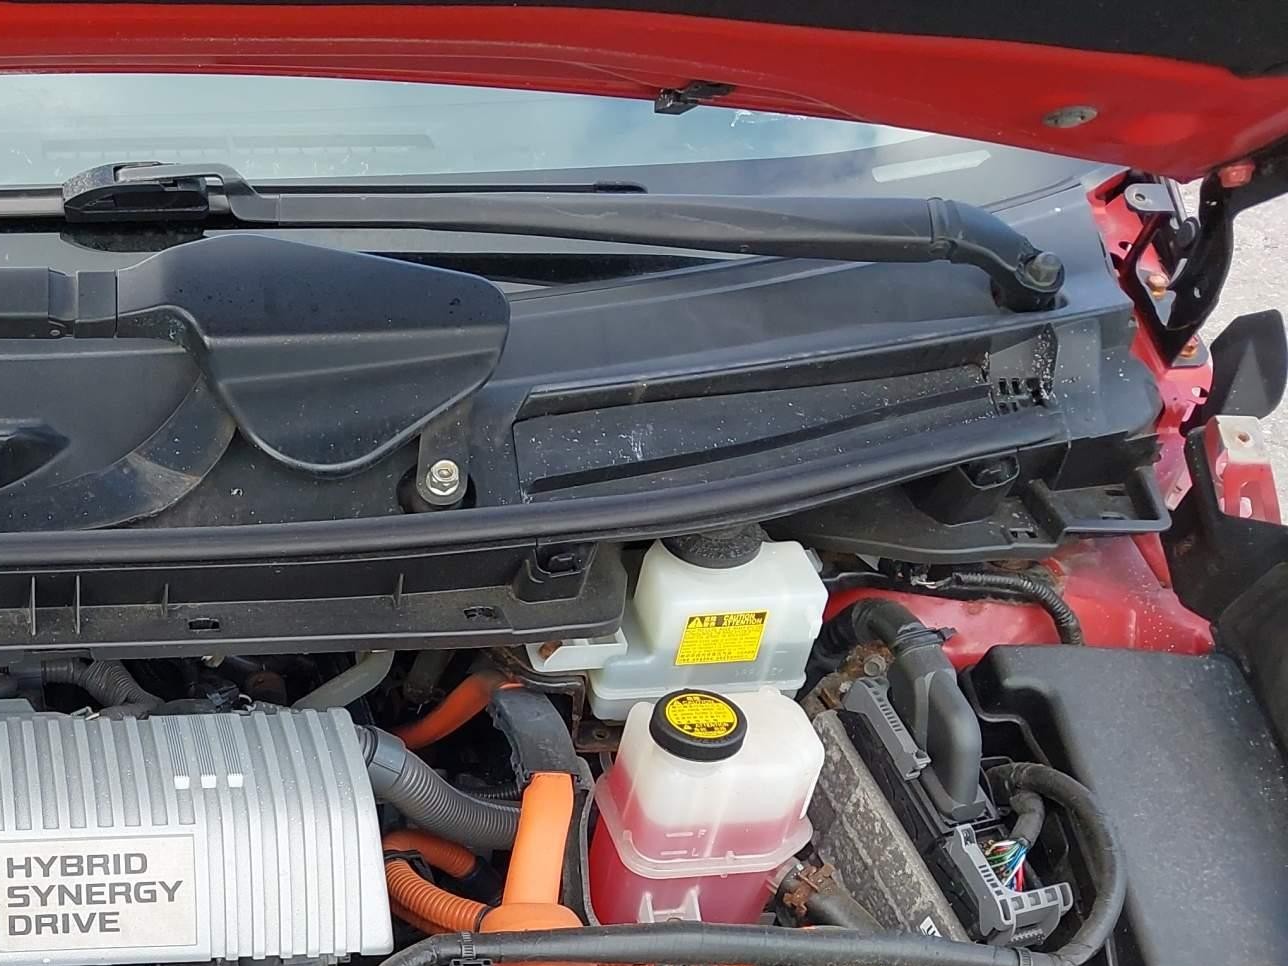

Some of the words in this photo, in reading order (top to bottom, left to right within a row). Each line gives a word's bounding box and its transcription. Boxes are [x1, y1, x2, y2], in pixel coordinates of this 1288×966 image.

[6, 853, 148, 879] HYBRID
[7, 880, 183, 908] SYNERGY
[8, 912, 121, 936] DRIVE
